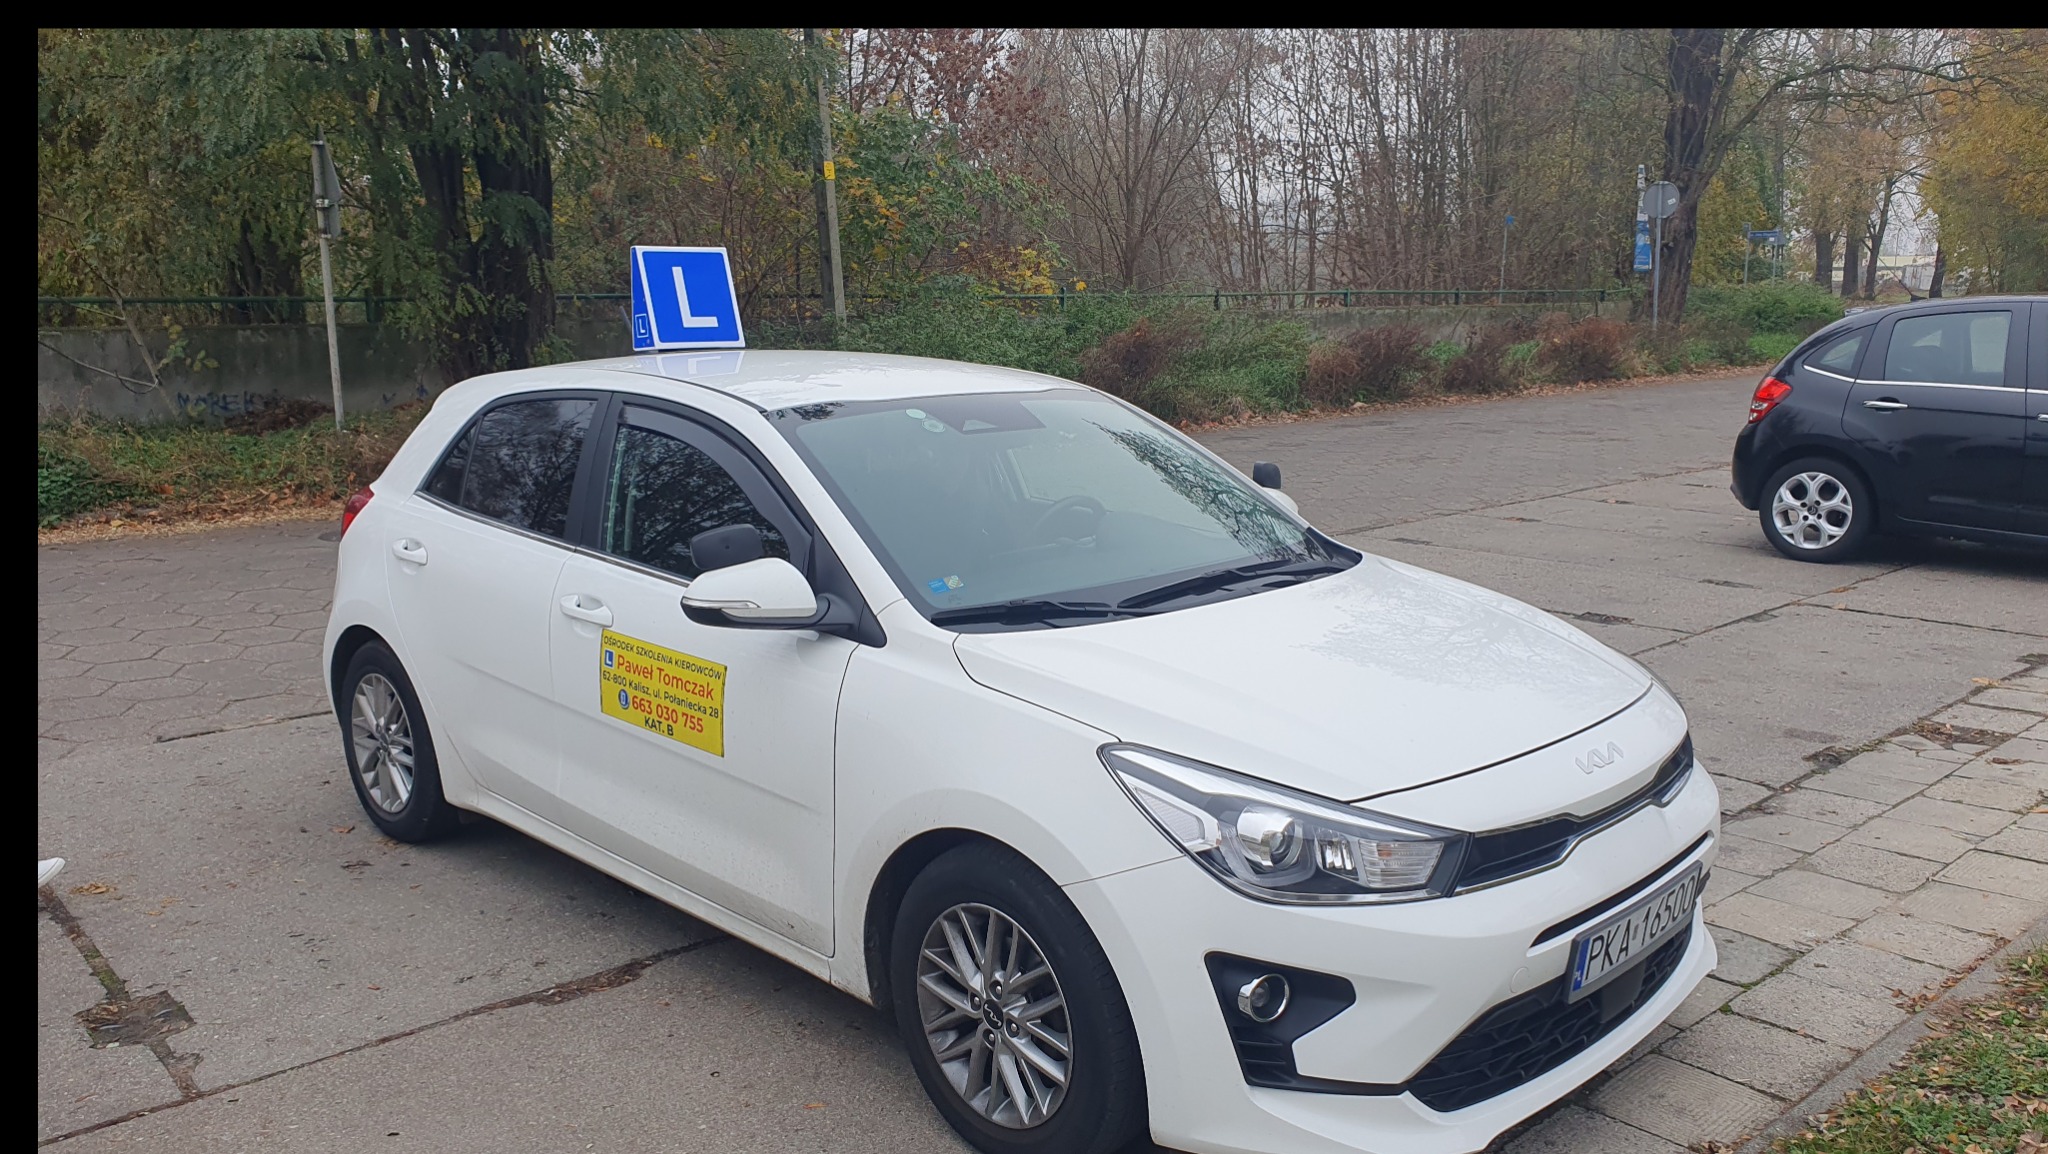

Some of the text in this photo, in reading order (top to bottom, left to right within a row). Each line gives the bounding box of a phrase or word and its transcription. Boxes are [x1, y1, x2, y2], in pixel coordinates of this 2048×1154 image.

[672, 266, 719, 328] L
[639, 319, 646, 333] L
[604, 635, 722, 680] OŚRODEK SZKOLENIA KIEROWCÓW
[606, 651, 613, 666] L
[617, 654, 714, 701] Paweł Tomczak
[602, 670, 627, 687] 62-800
[653, 688, 662, 699] ul.
[664, 691, 707, 715] Połaniecka
[709, 706, 719, 719] 28
[631, 695, 704, 733] 663 030 755
[644, 715, 674, 737] KAT. B
[1574, 741, 1624, 775] KIA
[1585, 875, 1696, 981] PKA 16500
